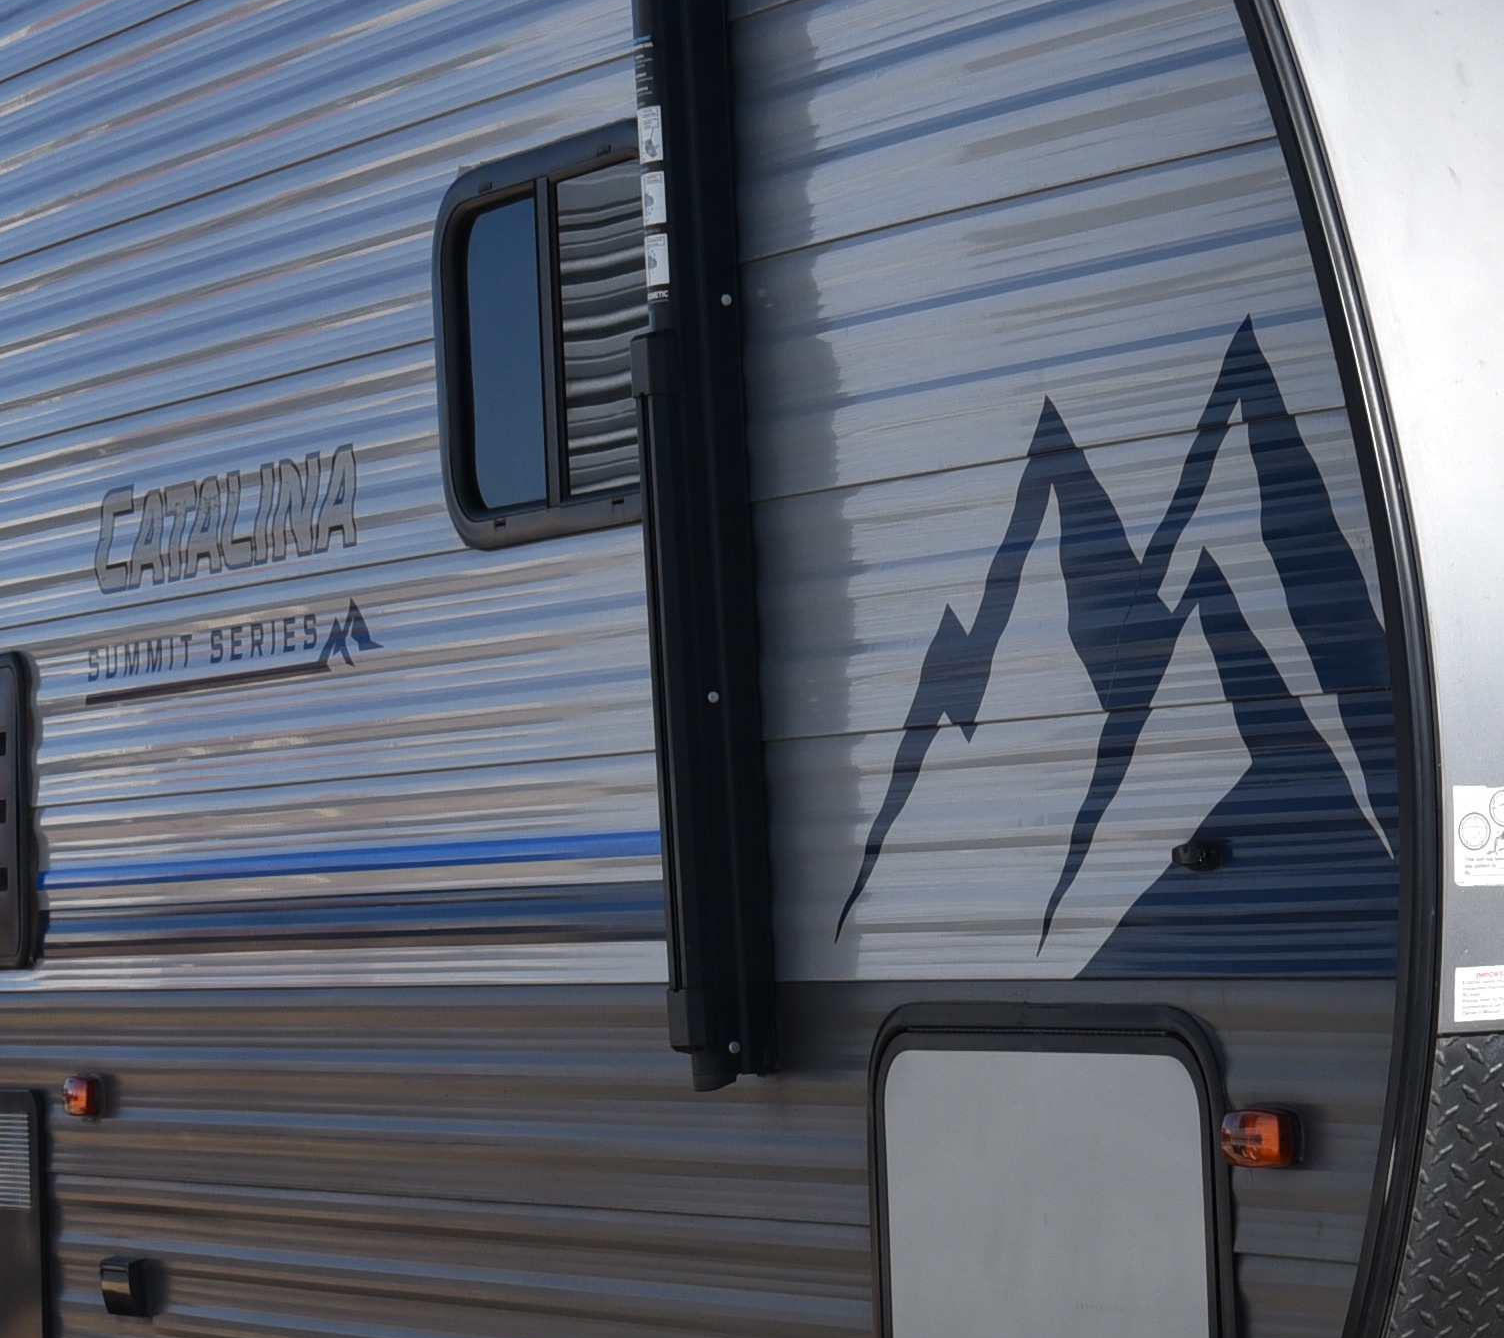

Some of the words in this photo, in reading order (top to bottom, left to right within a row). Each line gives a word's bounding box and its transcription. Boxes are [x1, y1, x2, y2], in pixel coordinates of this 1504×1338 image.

[94, 443, 358, 595] CATALINA
[87, 634, 193, 682] SUMMIT
[209, 614, 318, 664] SERIES
